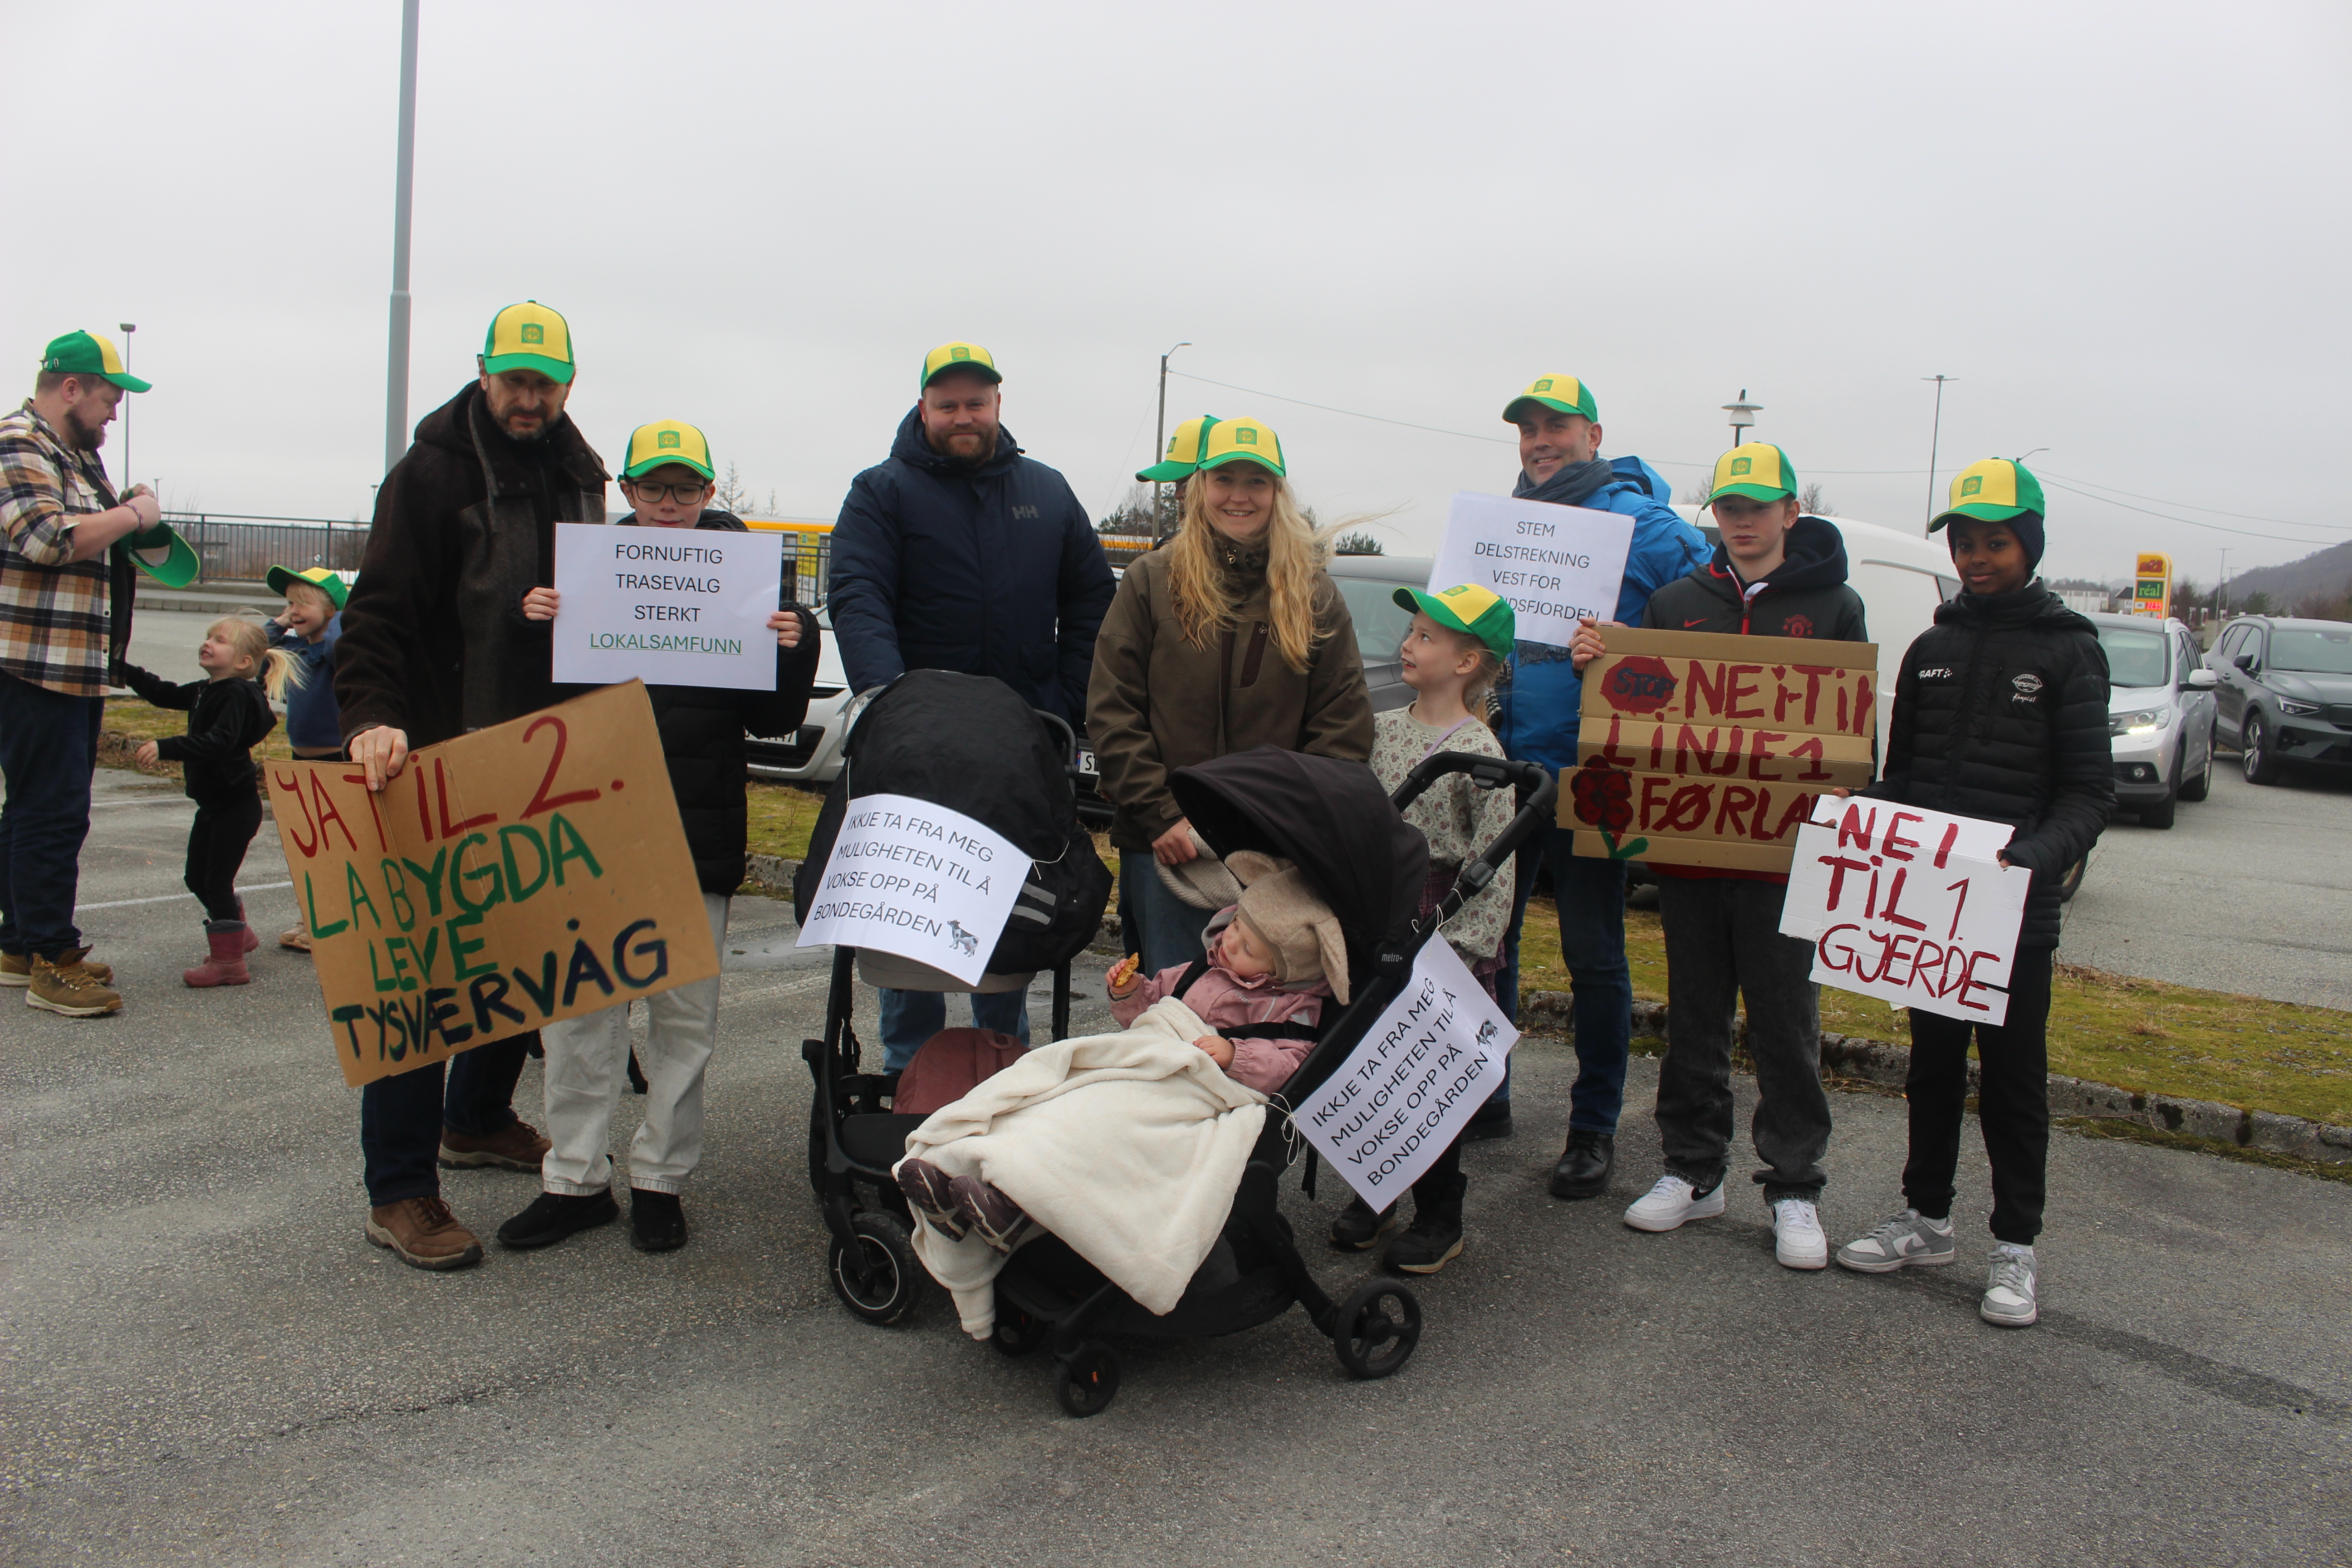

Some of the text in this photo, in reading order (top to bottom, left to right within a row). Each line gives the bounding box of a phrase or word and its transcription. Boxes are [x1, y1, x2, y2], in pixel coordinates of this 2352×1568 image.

[1012, 505, 1039, 519] HH
[1516, 521, 1555, 538] STEM
[615, 544, 723, 564] FORNUFTIG
[1475, 541, 1590, 568] DELSTREKNING
[615, 573, 720, 593] TRASEVALG
[1493, 569, 1561, 591] VEST FOR
[2139, 584, 2161, 597] réal
[634, 605, 701, 622] STERKT
[589, 633, 742, 656] LOKALSAMFUNN
[1613, 667, 1675, 701] STOP
[1788, 737, 1834, 781] 1
[274, 769, 358, 858] JA
[847, 812, 994, 862] IKKJE TA FRA MEG
[1838, 803, 1959, 869] NEI
[305, 812, 603, 939] LA BYGDA
[826, 871, 939, 903] VOKSE OPP PÅ
[836, 842, 991, 896] MULIGHETEN TIL Å
[813, 901, 942, 937] BONDEGÅRDEN
[369, 911, 498, 993] LEVE
[1382, 953, 1403, 962] metro+
[1818, 924, 2001, 1011] GJERDE
[332, 918, 668, 1062] TYSVÆRVÅG
[1312, 977, 1435, 1127] IKKJE TA FRA MEG
[1330, 987, 1456, 1147] MULIGHETEN TIL Å
[1348, 1043, 1463, 1165] VOKSE OPP PÅ
[1367, 1051, 1489, 1186] BONDEGÅRDEN
